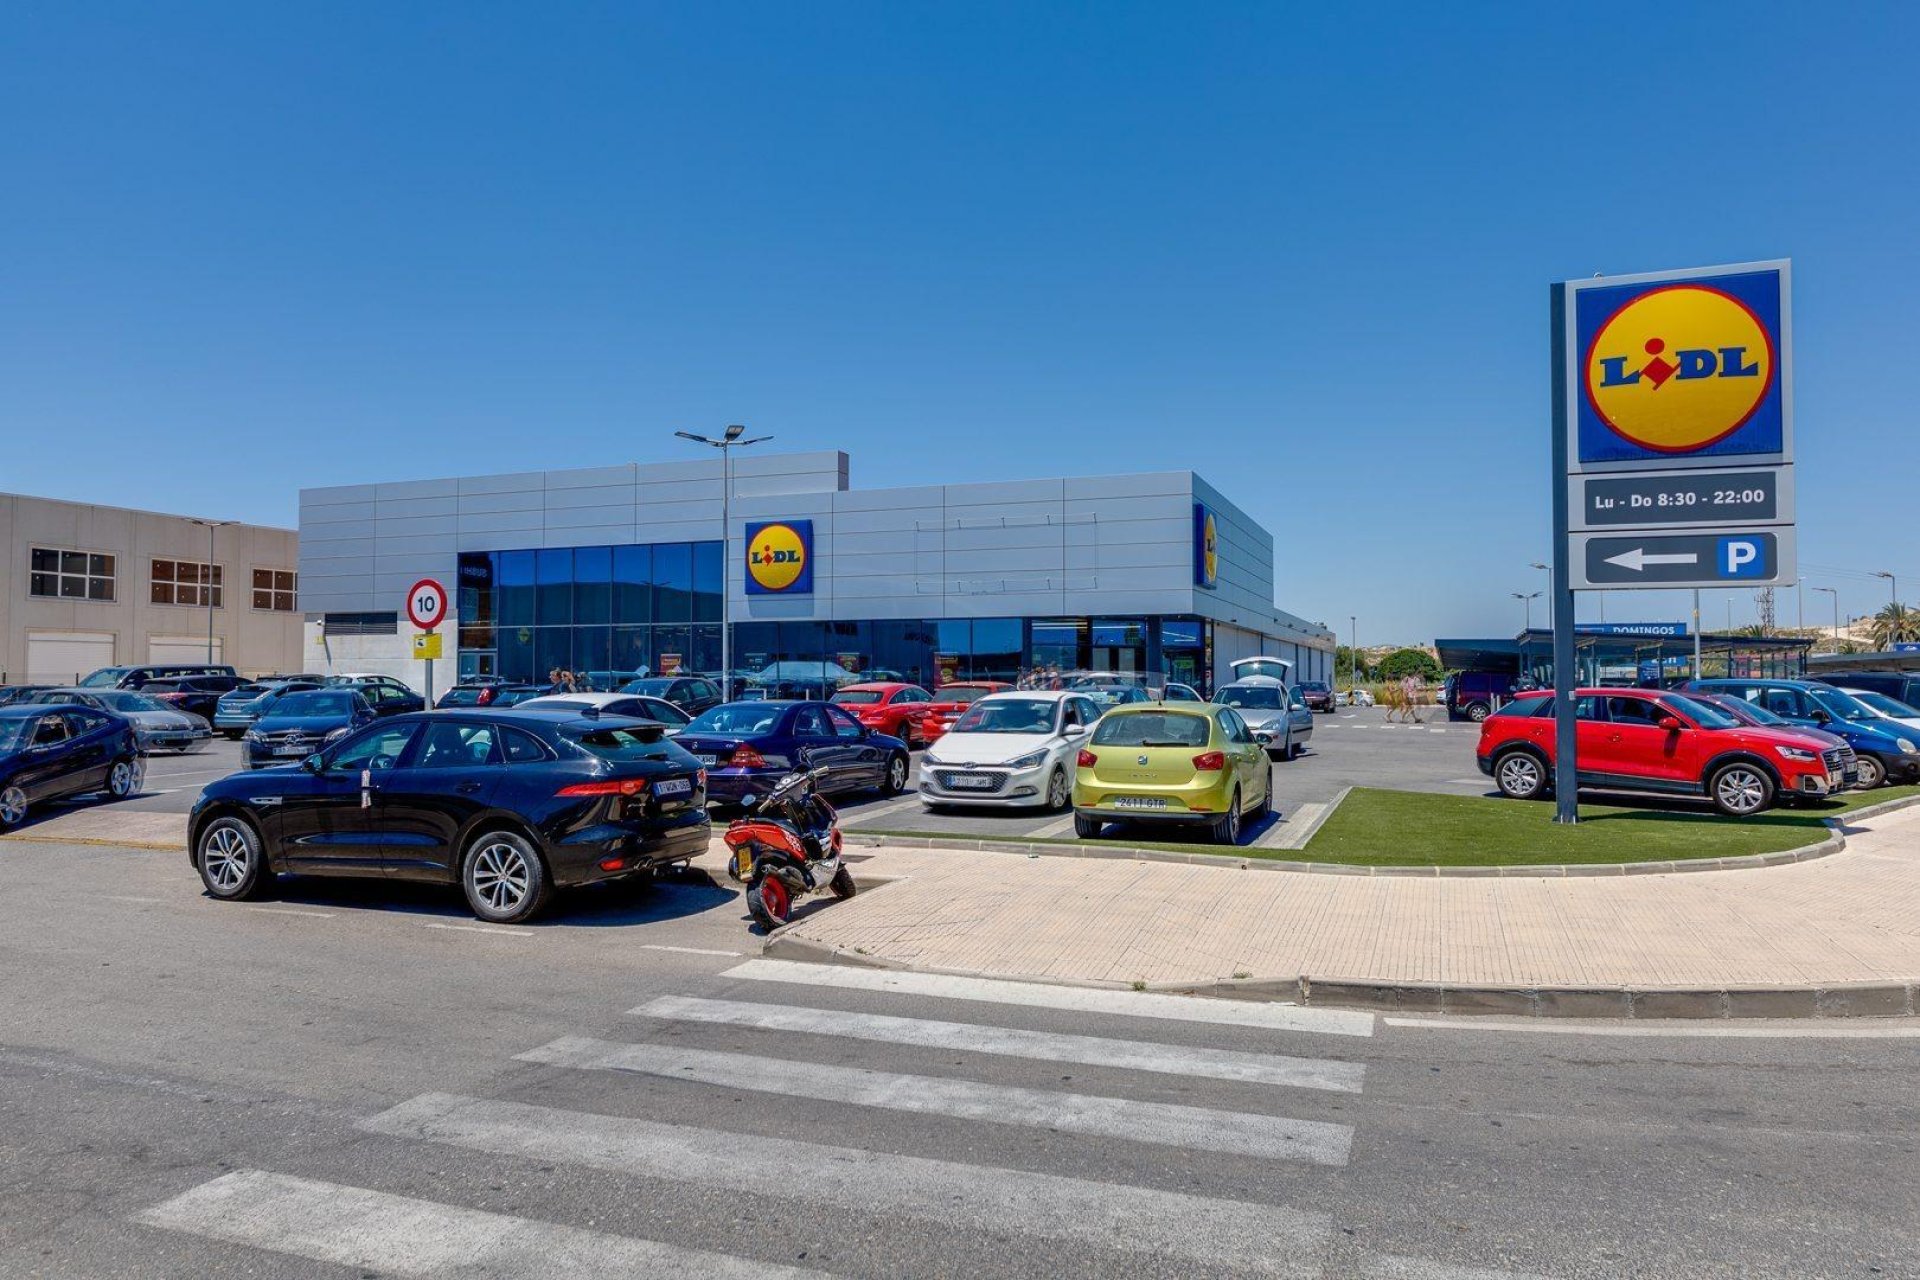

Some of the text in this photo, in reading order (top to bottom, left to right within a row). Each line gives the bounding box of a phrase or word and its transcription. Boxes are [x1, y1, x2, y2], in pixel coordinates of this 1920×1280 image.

[1595, 496, 1614, 509] Lu
[1631, 494, 1652, 508] Do
[1657, 492, 1697, 507] 8:30
[1713, 489, 1765, 505] 22:00
[1727, 541, 1756, 573] P
[417, 595, 435, 613] 10
[1612, 626, 1676, 635] DOMINGOS
